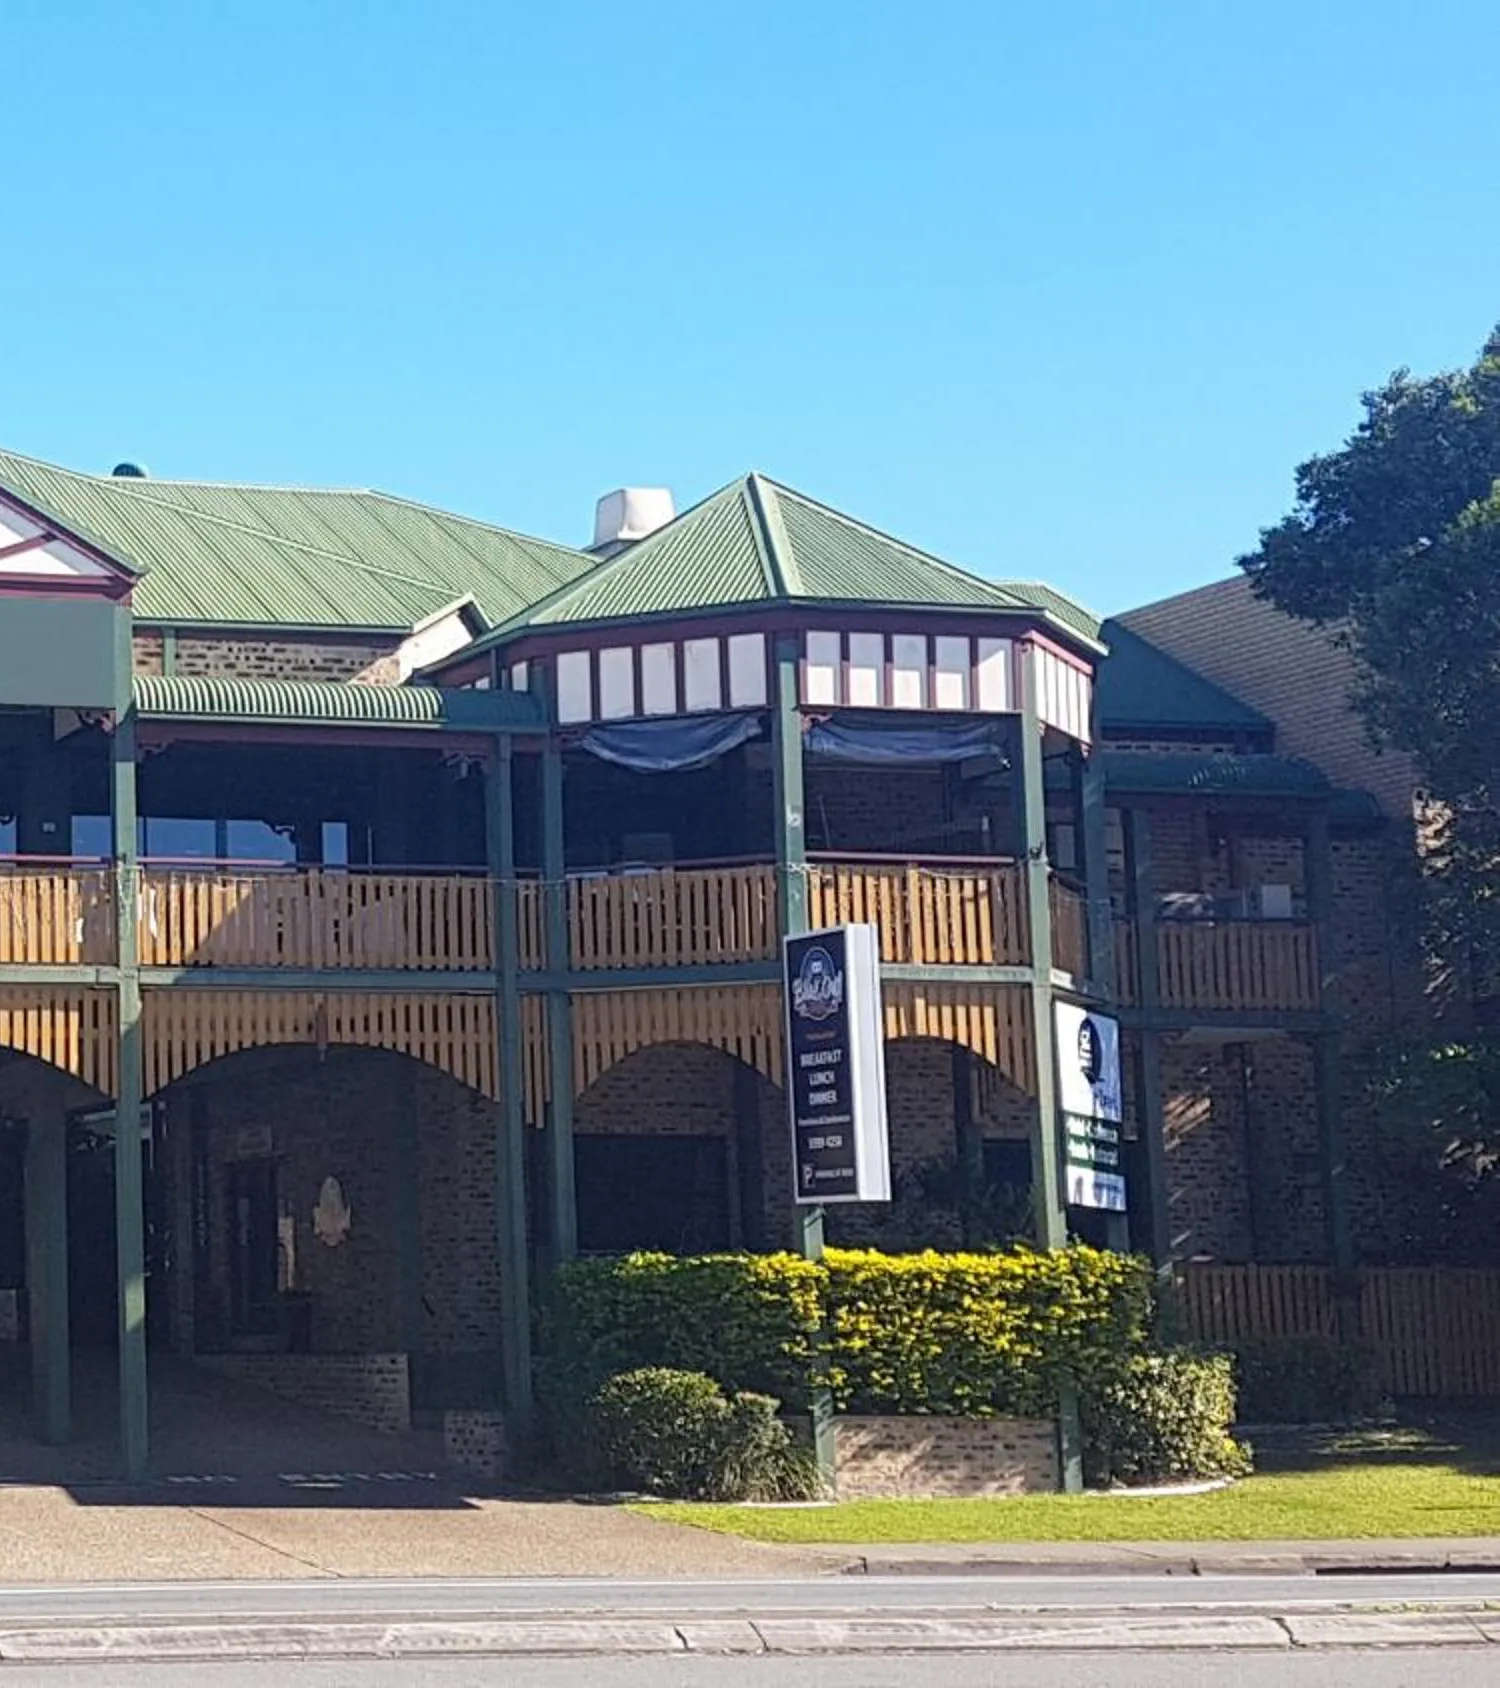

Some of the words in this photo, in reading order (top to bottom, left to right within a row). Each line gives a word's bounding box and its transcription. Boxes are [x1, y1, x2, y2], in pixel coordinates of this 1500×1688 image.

[800, 1049, 842, 1067] BREAKFAST
[808, 1070, 836, 1087] LUNCH
[808, 1090, 838, 1106] DINNER
